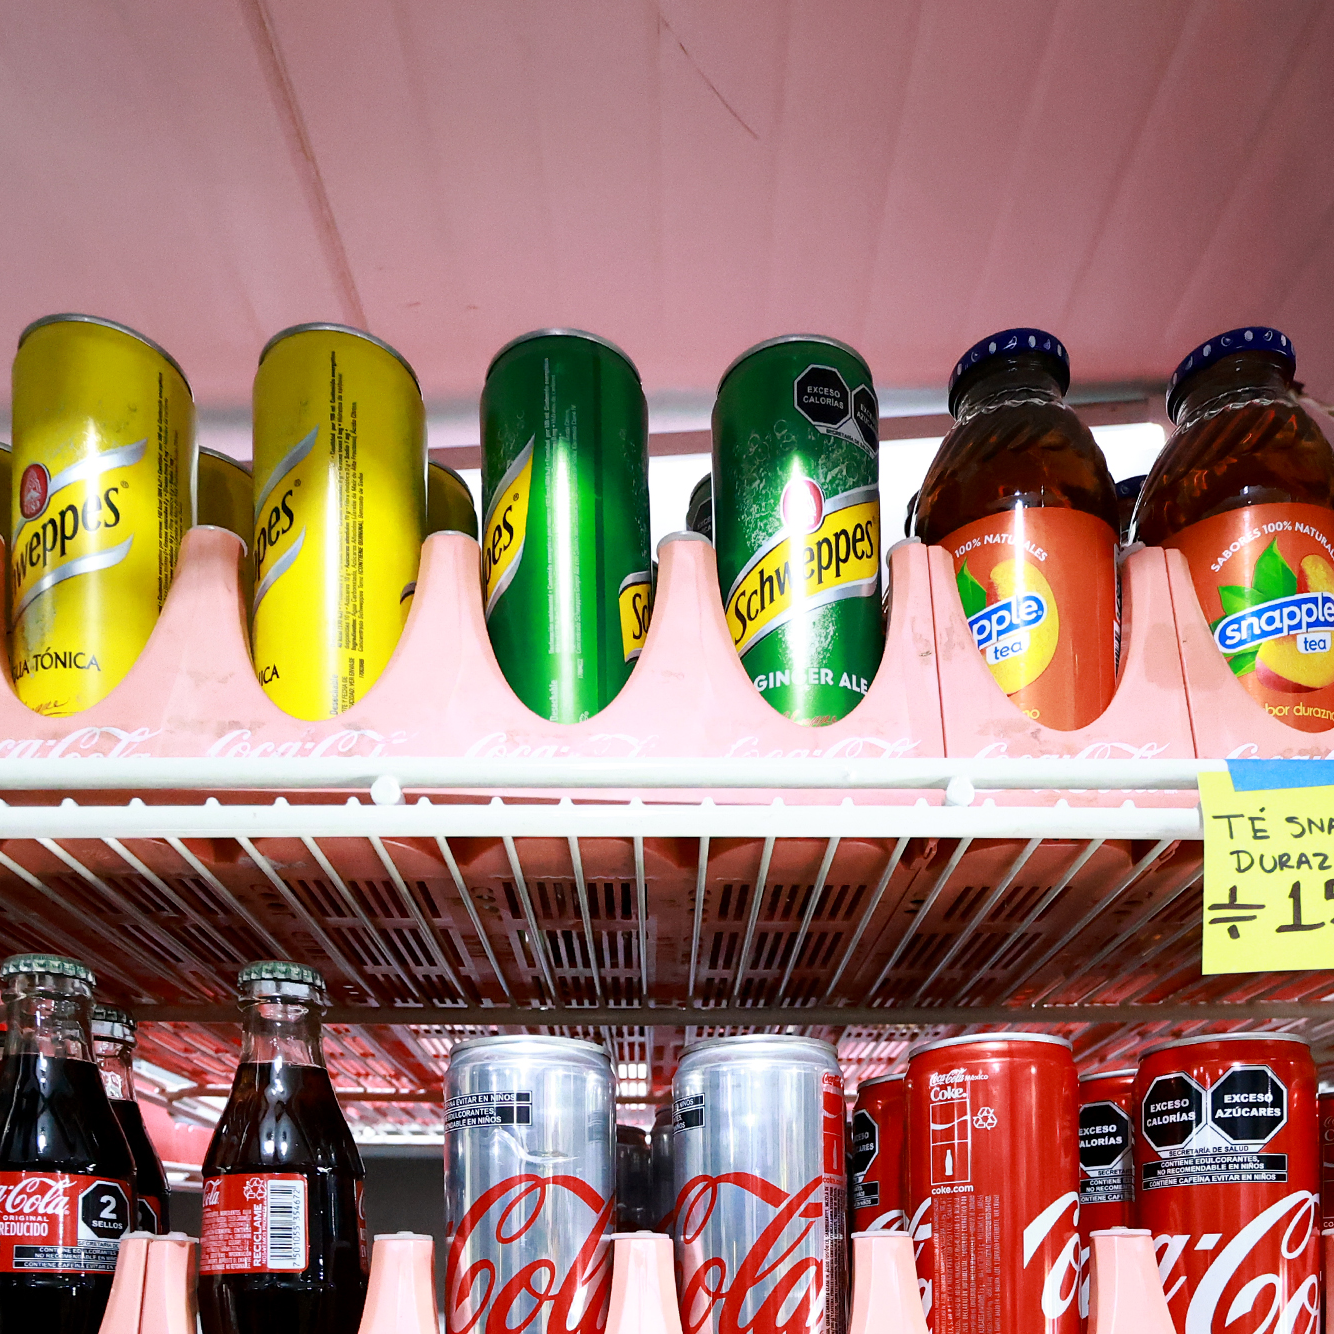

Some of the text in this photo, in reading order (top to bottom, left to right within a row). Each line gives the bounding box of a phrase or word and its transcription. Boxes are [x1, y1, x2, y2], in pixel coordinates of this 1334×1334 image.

[807, 386, 841, 398] EXCESO
[802, 395, 844, 410] CALORÍAS
[954, 533, 1048, 563] 100% NATUALES
[1211, 528, 1262, 573] SABORES
[1262, 520, 1293, 536] 100%
[733, 518, 875, 646] Schweppes
[972, 594, 1040, 647] pple
[993, 638, 1023, 660] tea
[1303, 636, 1327, 653] tea
[33, 646, 101, 671] TÓNICA
[754, 667, 869, 695] GINGER ALE
[549, 680, 558, 721] Desechable
[1212, 807, 1270, 840] TÉ
[929, 1067, 968, 1087] Coca-Cola
[478, 1095, 490, 1104] EN
[490, 1092, 516, 1103] NIÑOS
[930, 1086, 968, 1102] Coke.
[1224, 1093, 1274, 1104] EXCESO
[1150, 1099, 1190, 1113] EXCESO
[1215, 1106, 1282, 1119] AZÚCARES
[467, 1115, 502, 1126] EN NIÑOS
[1146, 1111, 1196, 1127] CALORÍAS
[1079, 1124, 1117, 1136] EXCESO
[1079, 1135, 1123, 1149] ALORÍAS
[1168, 1146, 1211, 1157] SECRETARÍA
[1224, 1145, 1249, 1153] SALUD
[1156, 1168, 1167, 1176] NO
[1166, 1164, 1227, 1175] RECOMENDABLE
[1238, 1161, 1265, 1170] NIÑOS
[1160, 1155, 1260, 1168] CONTIENE EDULCORANTES,
[1149, 1178, 1178, 1188] CONTIENE
[1178, 1175, 1211, 1184] CAFEÍNA
[1211, 1174, 1240, 1182] EVITAR
[1254, 1171, 1277, 1181] NIÑOS
[931, 1184, 975, 1195] coke.com
[99, 1195, 117, 1220] 2
[293, 1189, 301, 1221] 354672
[91, 1220, 123, 1230] SELLOS
[253, 1203, 262, 1267] RECICLAME
